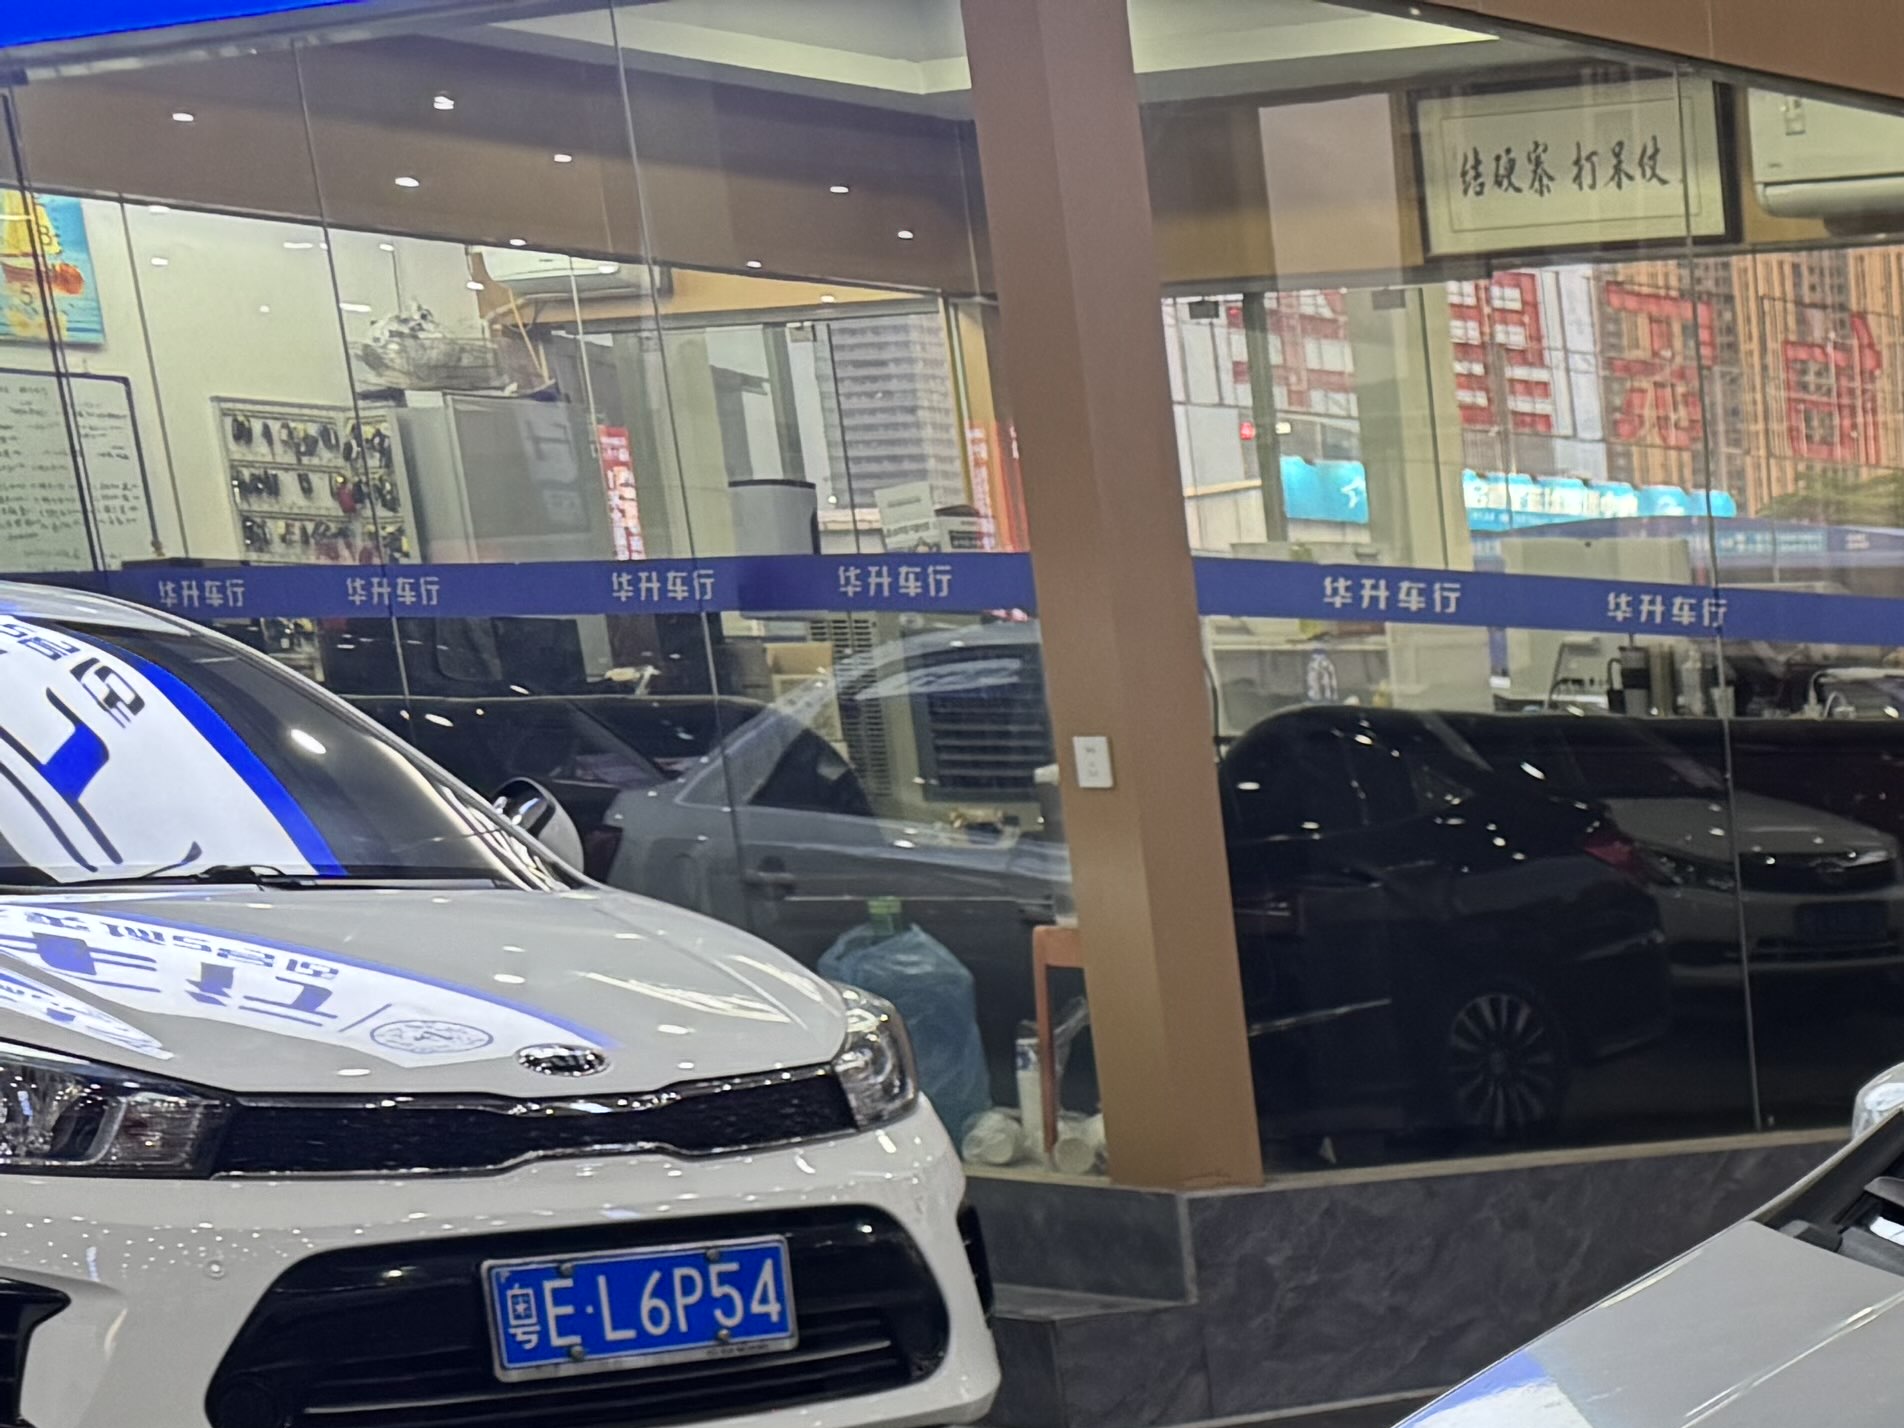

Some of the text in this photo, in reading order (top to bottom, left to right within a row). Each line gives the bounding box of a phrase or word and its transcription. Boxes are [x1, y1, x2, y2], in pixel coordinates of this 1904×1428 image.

[158, 577, 247, 610] 华升车行
[346, 575, 440, 608] 华升车行
[611, 568, 716, 603] 华升车行
[838, 563, 953, 598] 华升车行
[1322, 575, 1462, 614] 华升车行
[1606, 591, 1728, 630] 华升车行
